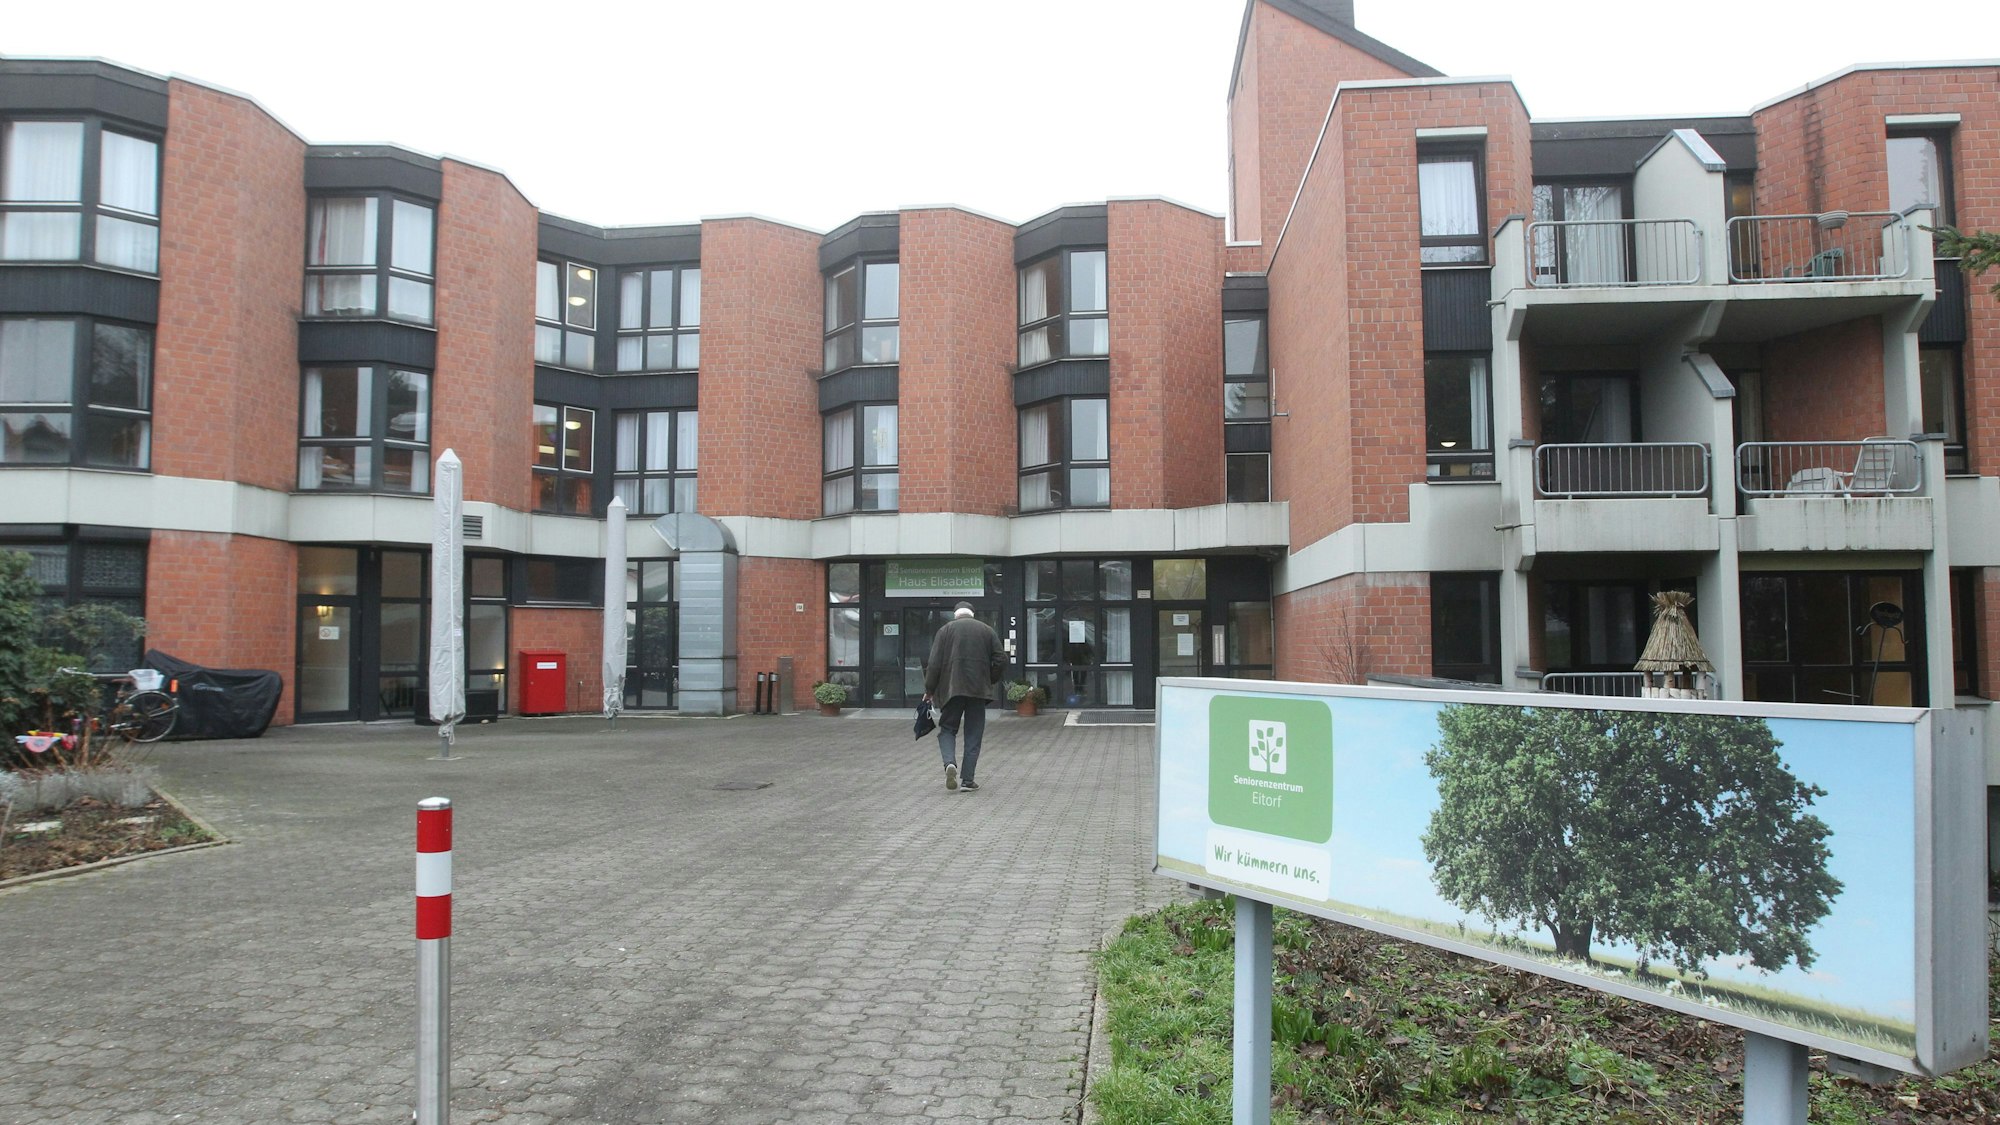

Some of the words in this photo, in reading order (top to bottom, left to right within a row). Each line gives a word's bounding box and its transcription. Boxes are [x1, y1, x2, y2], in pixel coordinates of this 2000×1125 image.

[899, 577, 927, 587] Haus
[930, 575, 982, 587] Elisabeth
[1010, 617, 1016, 626] 5
[1234, 775, 1303, 792] Seniorenzentrum
[1252, 792, 1282, 808] Eitorf
[1214, 844, 1232, 862] Wir
[1238, 849, 1288, 875] kümmern
[1294, 867, 1320, 884] uns.
